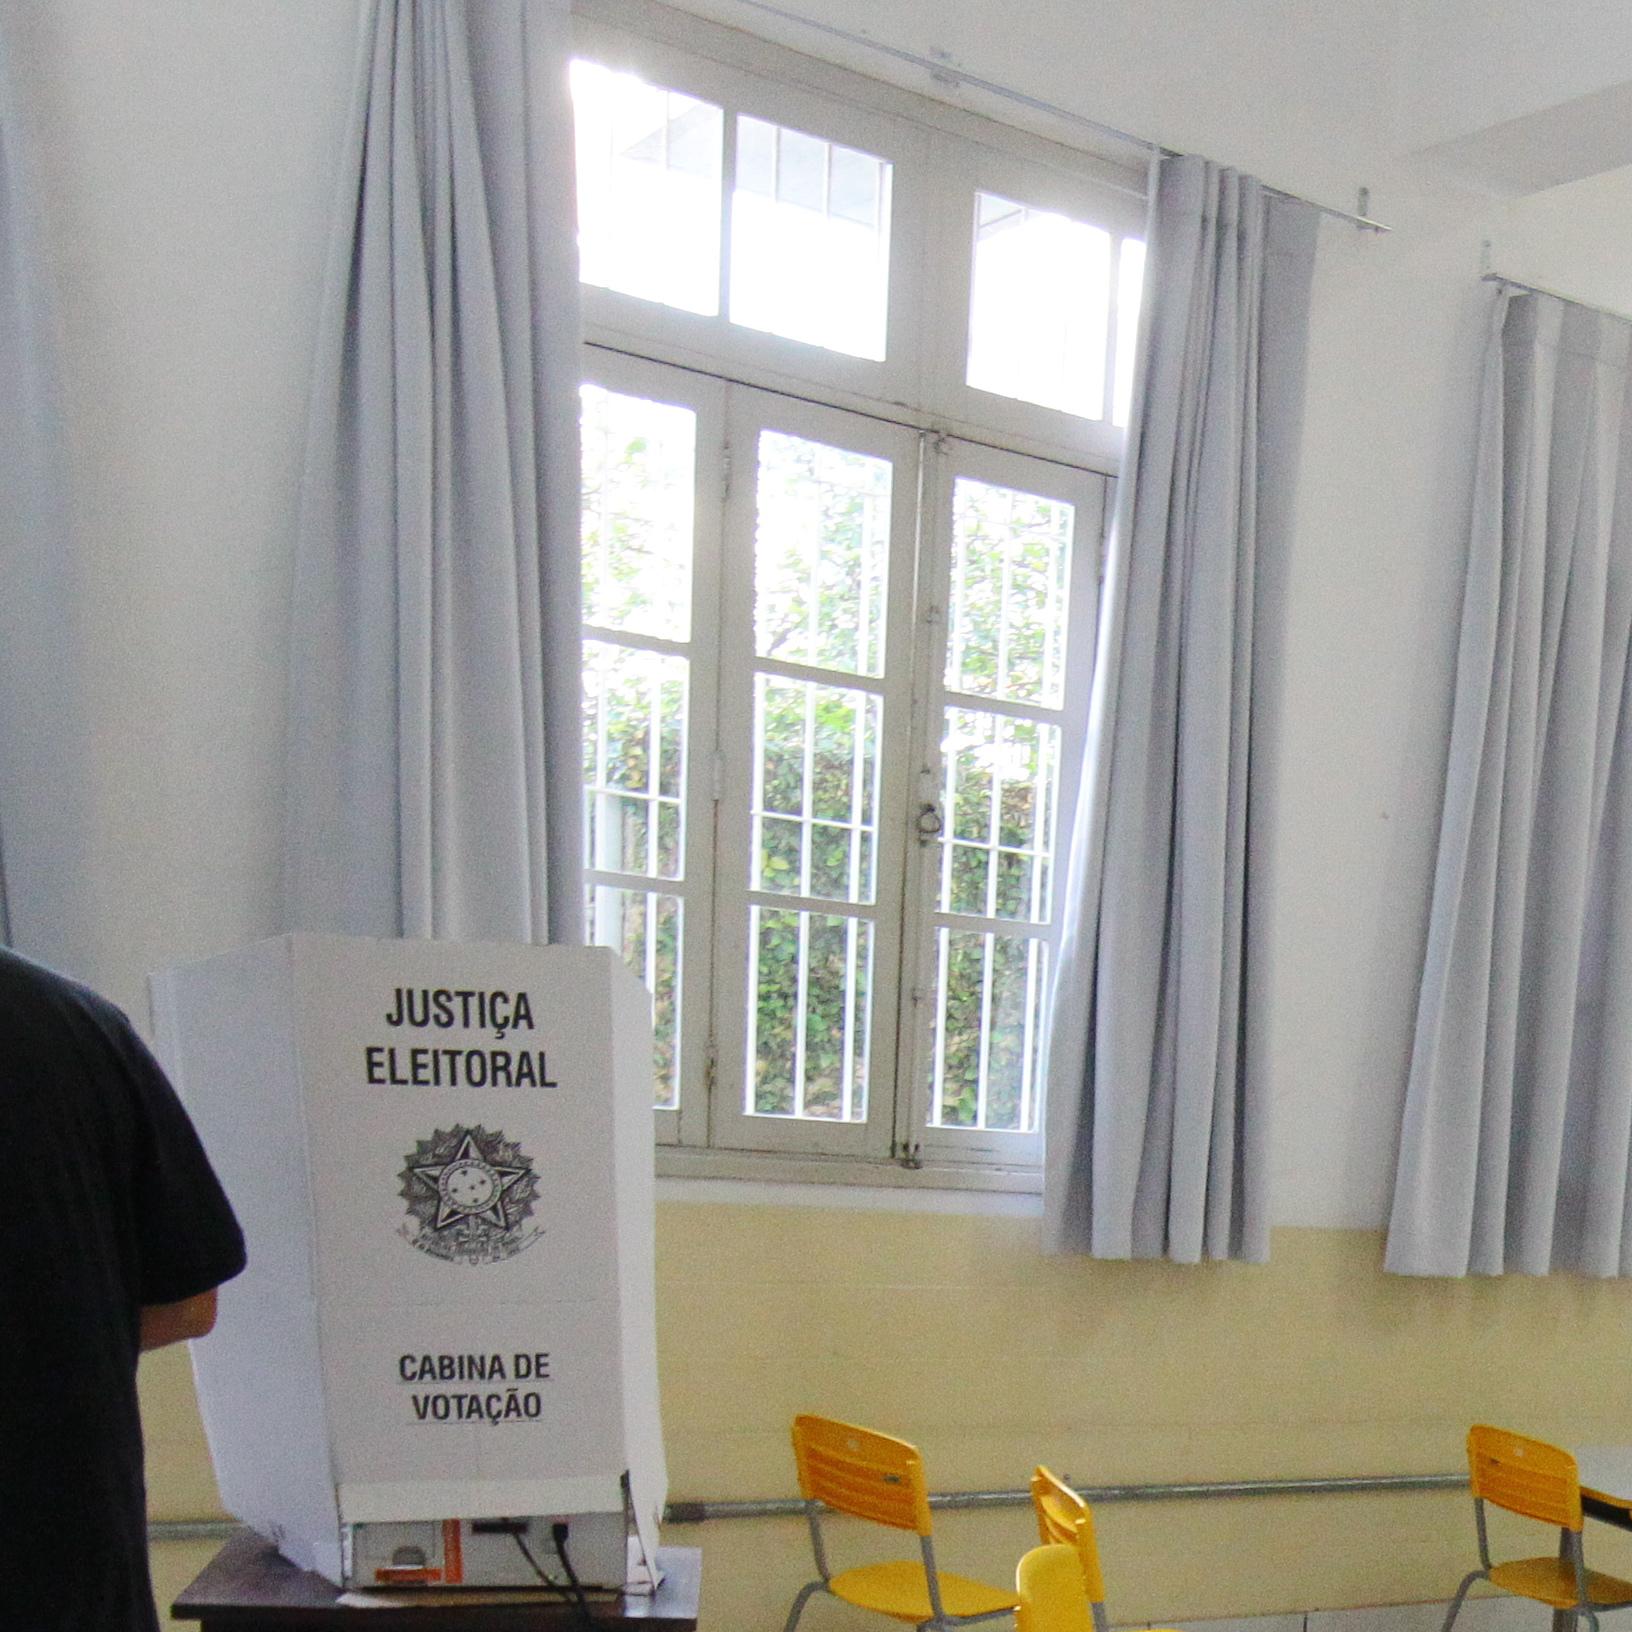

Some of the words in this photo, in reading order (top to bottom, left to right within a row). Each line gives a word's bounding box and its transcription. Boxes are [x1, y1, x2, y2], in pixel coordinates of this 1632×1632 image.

[386, 987, 535, 1039] JUSTIÇA
[368, 1046, 558, 1088] ELEITORAL
[400, 1353, 506, 1381] CABINA
[514, 1353, 550, 1379] DE
[411, 1388, 542, 1426] VOTAÇÃO
